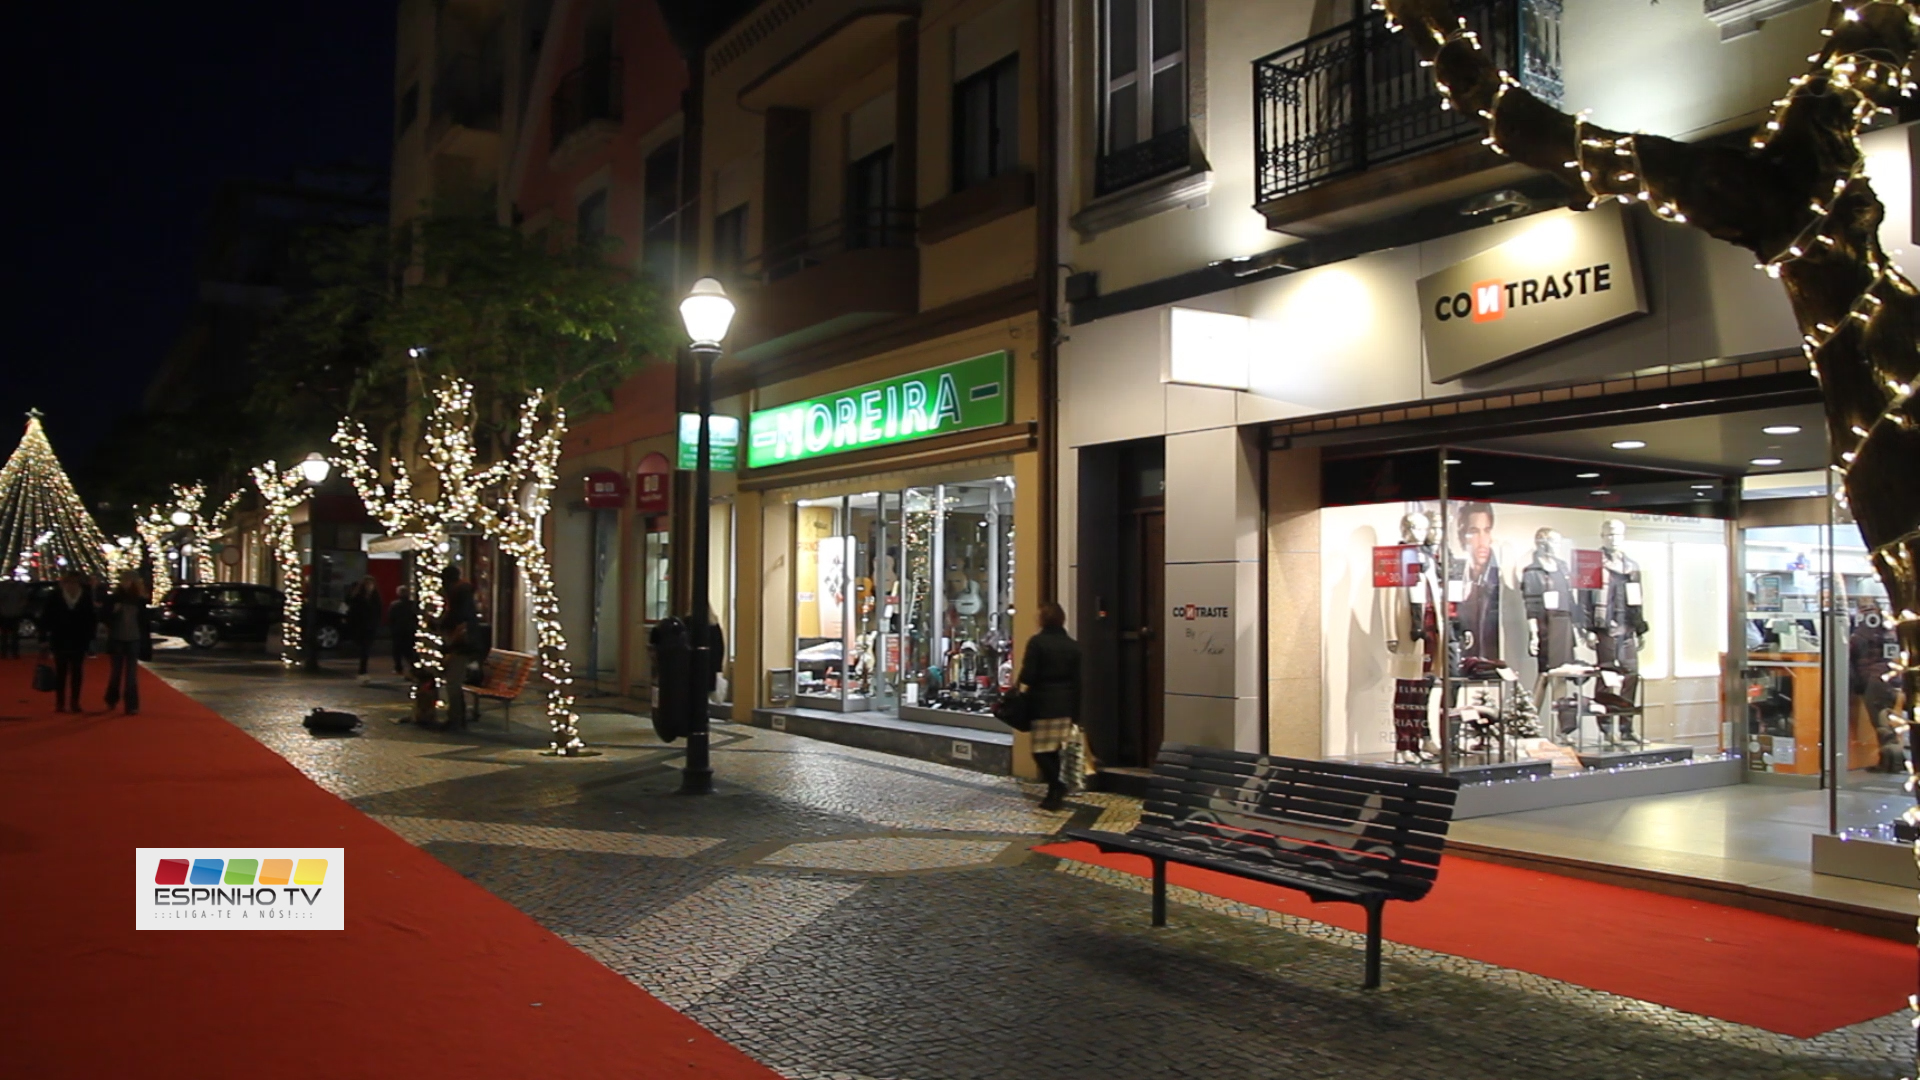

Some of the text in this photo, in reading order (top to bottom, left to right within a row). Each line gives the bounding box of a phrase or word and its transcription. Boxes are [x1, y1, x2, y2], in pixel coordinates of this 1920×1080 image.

[1435, 263, 1611, 322] CONTRASTE
[775, 373, 962, 459] MOREIRA
[1172, 604, 1229, 620] CONTRASTE
